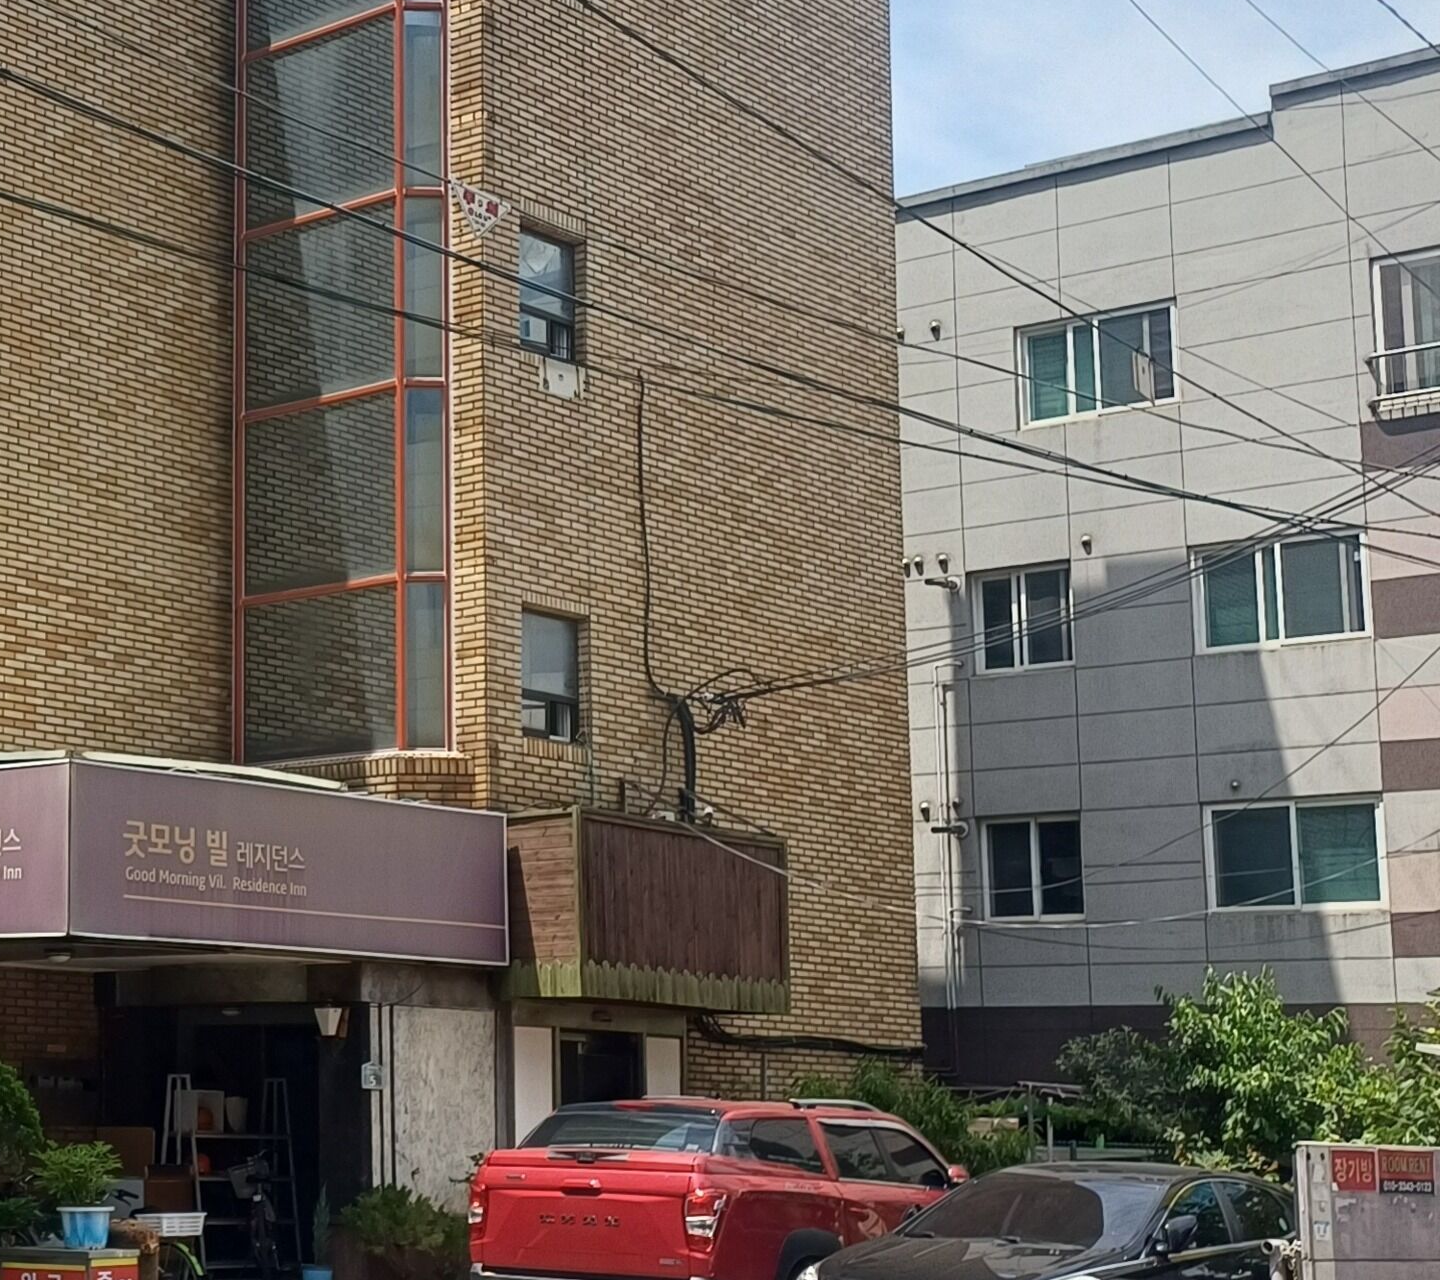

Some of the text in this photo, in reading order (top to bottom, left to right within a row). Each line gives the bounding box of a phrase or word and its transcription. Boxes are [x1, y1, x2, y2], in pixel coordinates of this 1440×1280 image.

[123, 820, 306, 872] 굿모닝 빌 레지던스
[3, 865, 22, 880] Inn
[125, 866, 307, 896] Good Morning Vil. Residence Inn
[1335, 1157, 1373, 1183] 장기방
[1382, 1156, 1431, 1174] ROOM RENT
